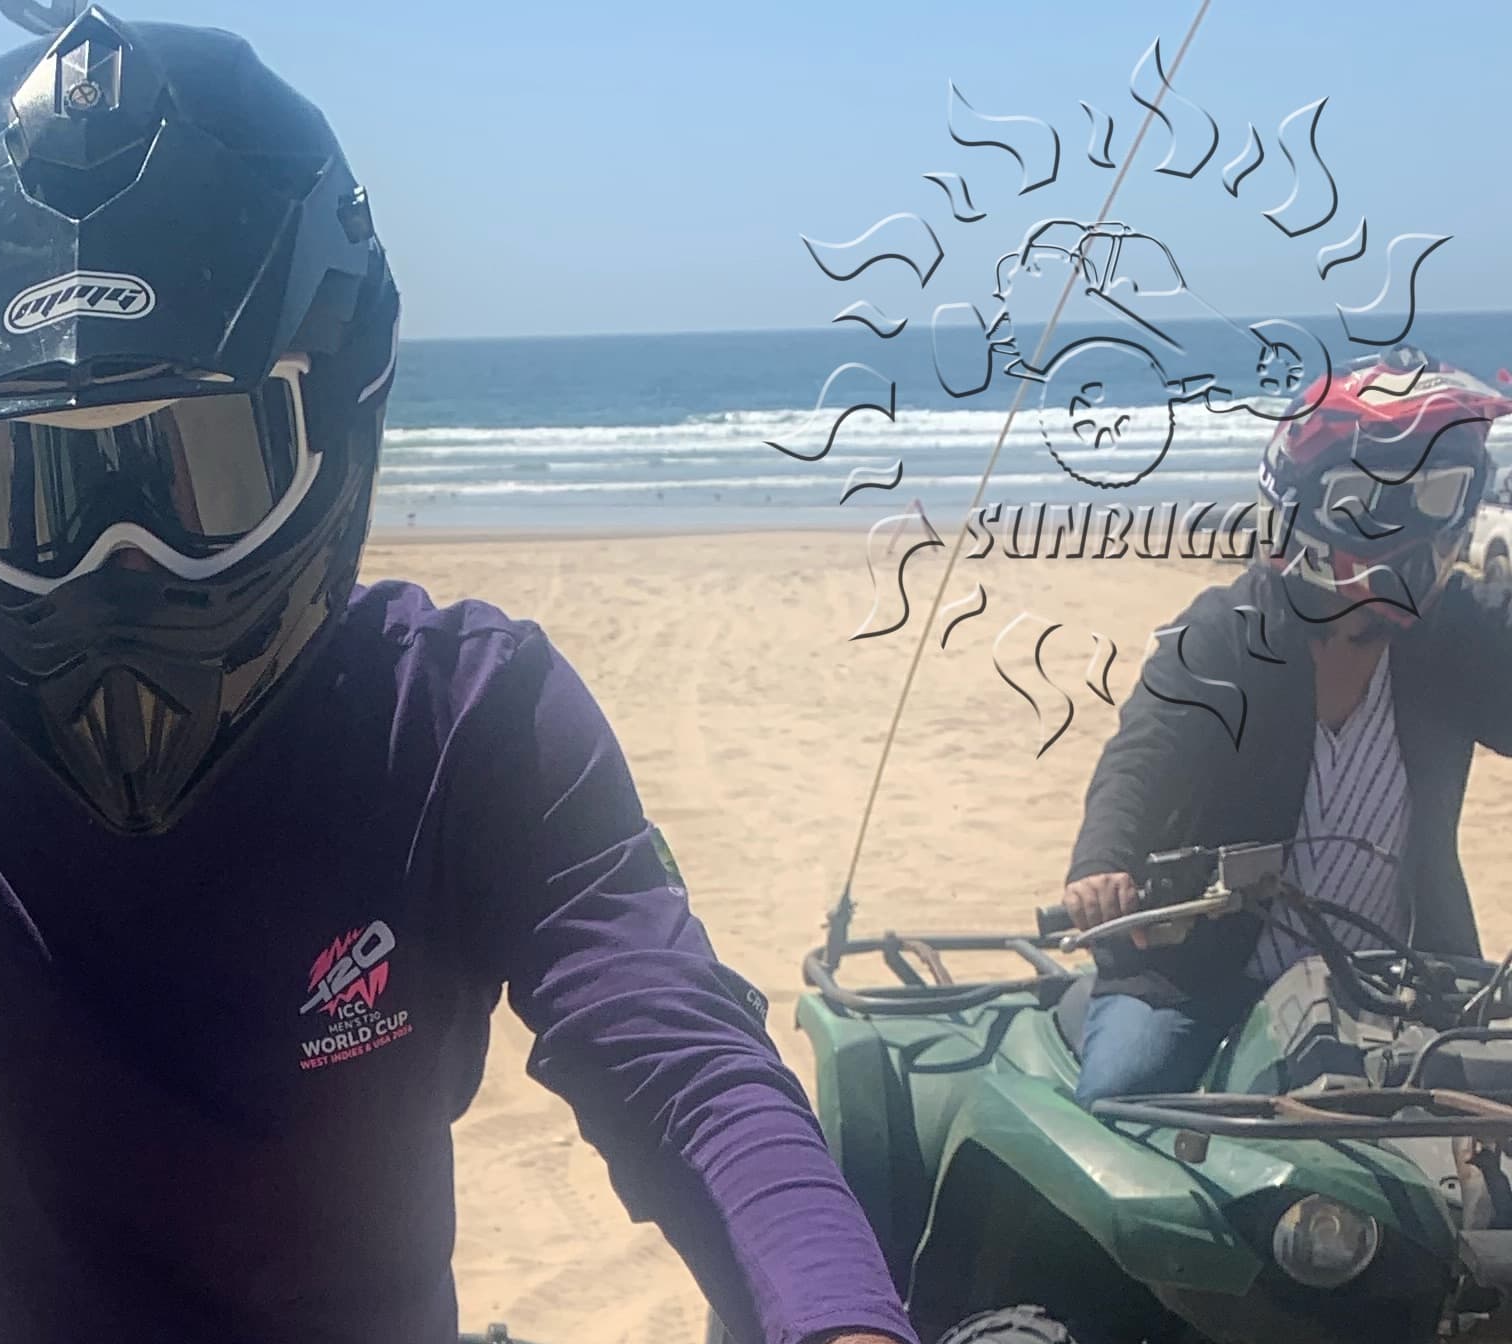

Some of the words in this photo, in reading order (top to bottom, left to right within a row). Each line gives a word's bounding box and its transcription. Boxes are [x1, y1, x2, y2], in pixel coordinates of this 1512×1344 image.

[338, 1001, 367, 1020] ICC
[363, 1011, 382, 1025] T20
[302, 1027, 372, 1058] WORLD
[375, 1010, 409, 1036] CUP
[299, 1057, 329, 1070] WEST
[331, 1046, 364, 1064] INDIES
[373, 1036, 391, 1050] USA
